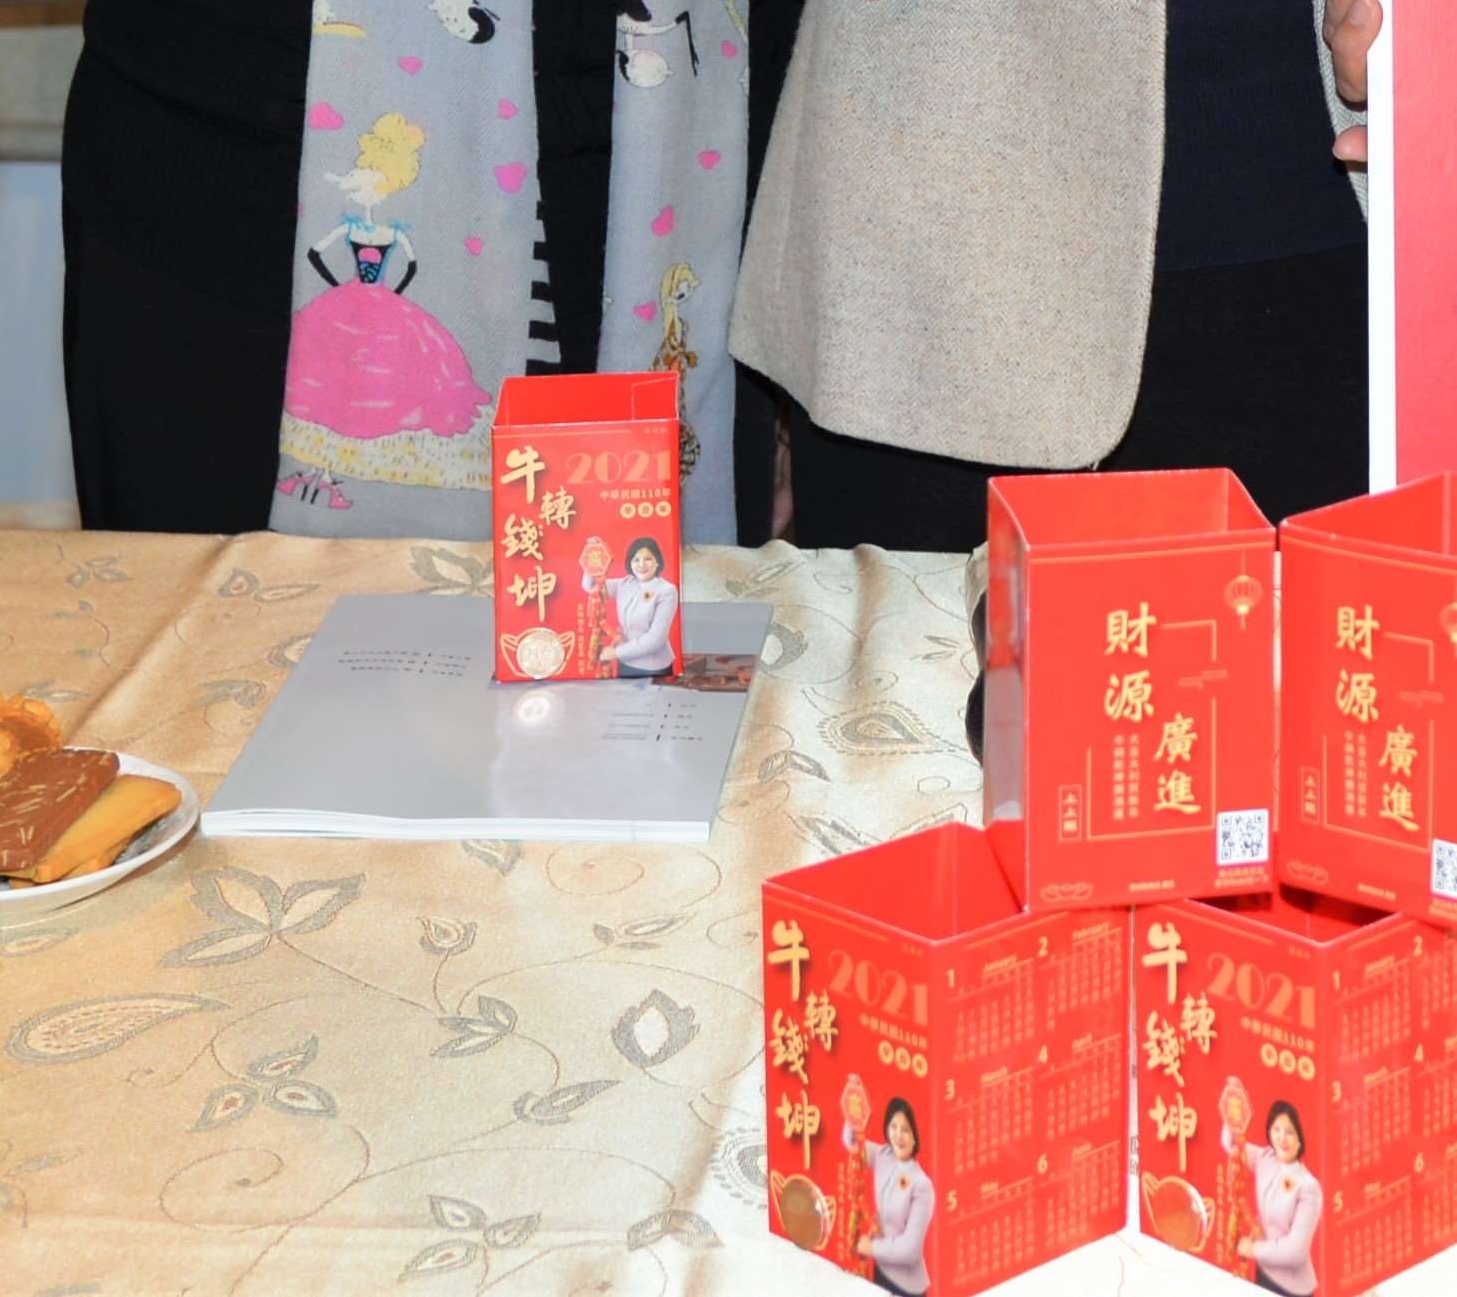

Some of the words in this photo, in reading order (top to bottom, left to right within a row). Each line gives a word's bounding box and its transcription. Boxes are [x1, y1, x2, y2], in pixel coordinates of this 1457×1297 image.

[565, 449, 672, 485] 2021
[1104, 602, 1157, 723] 財源
[1334, 604, 1380, 724] 財源
[1154, 709, 1202, 814] 廣進
[1379, 724, 1420, 833] 廣進
[826, 947, 930, 1026] 2021
[1207, 952, 1316, 1027] 2021
